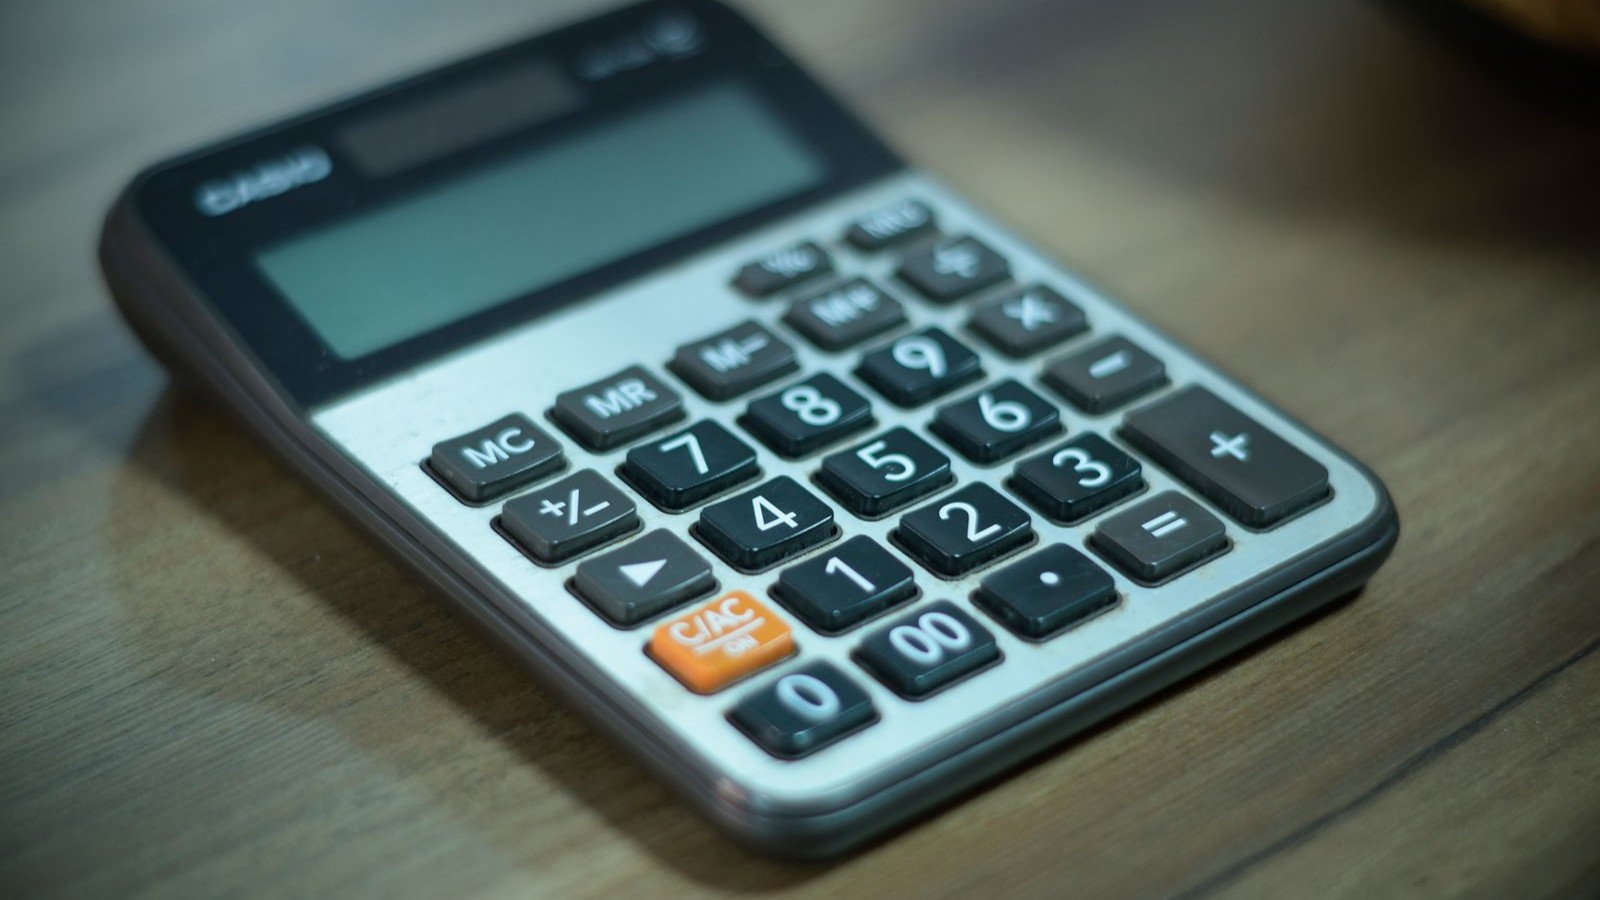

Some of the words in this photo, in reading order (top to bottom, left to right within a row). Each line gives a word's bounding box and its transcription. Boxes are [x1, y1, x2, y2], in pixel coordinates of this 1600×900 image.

[197, 145, 334, 217] CASIO
[891, 335, 948, 378] 9
[585, 378, 658, 418] MR
[780, 384, 843, 427] 8
[977, 392, 1031, 433] 6
[462, 428, 536, 468] MC
[659, 433, 710, 475] 7
[855, 441, 916, 481] 5
[1052, 447, 1113, 488] 3
[751, 495, 799, 532] 4
[938, 501, 1001, 542] 2
[825, 556, 876, 593] 1
[669, 597, 756, 646] C/AC
[888, 611, 972, 664] 00
[774, 673, 841, 720] 0
